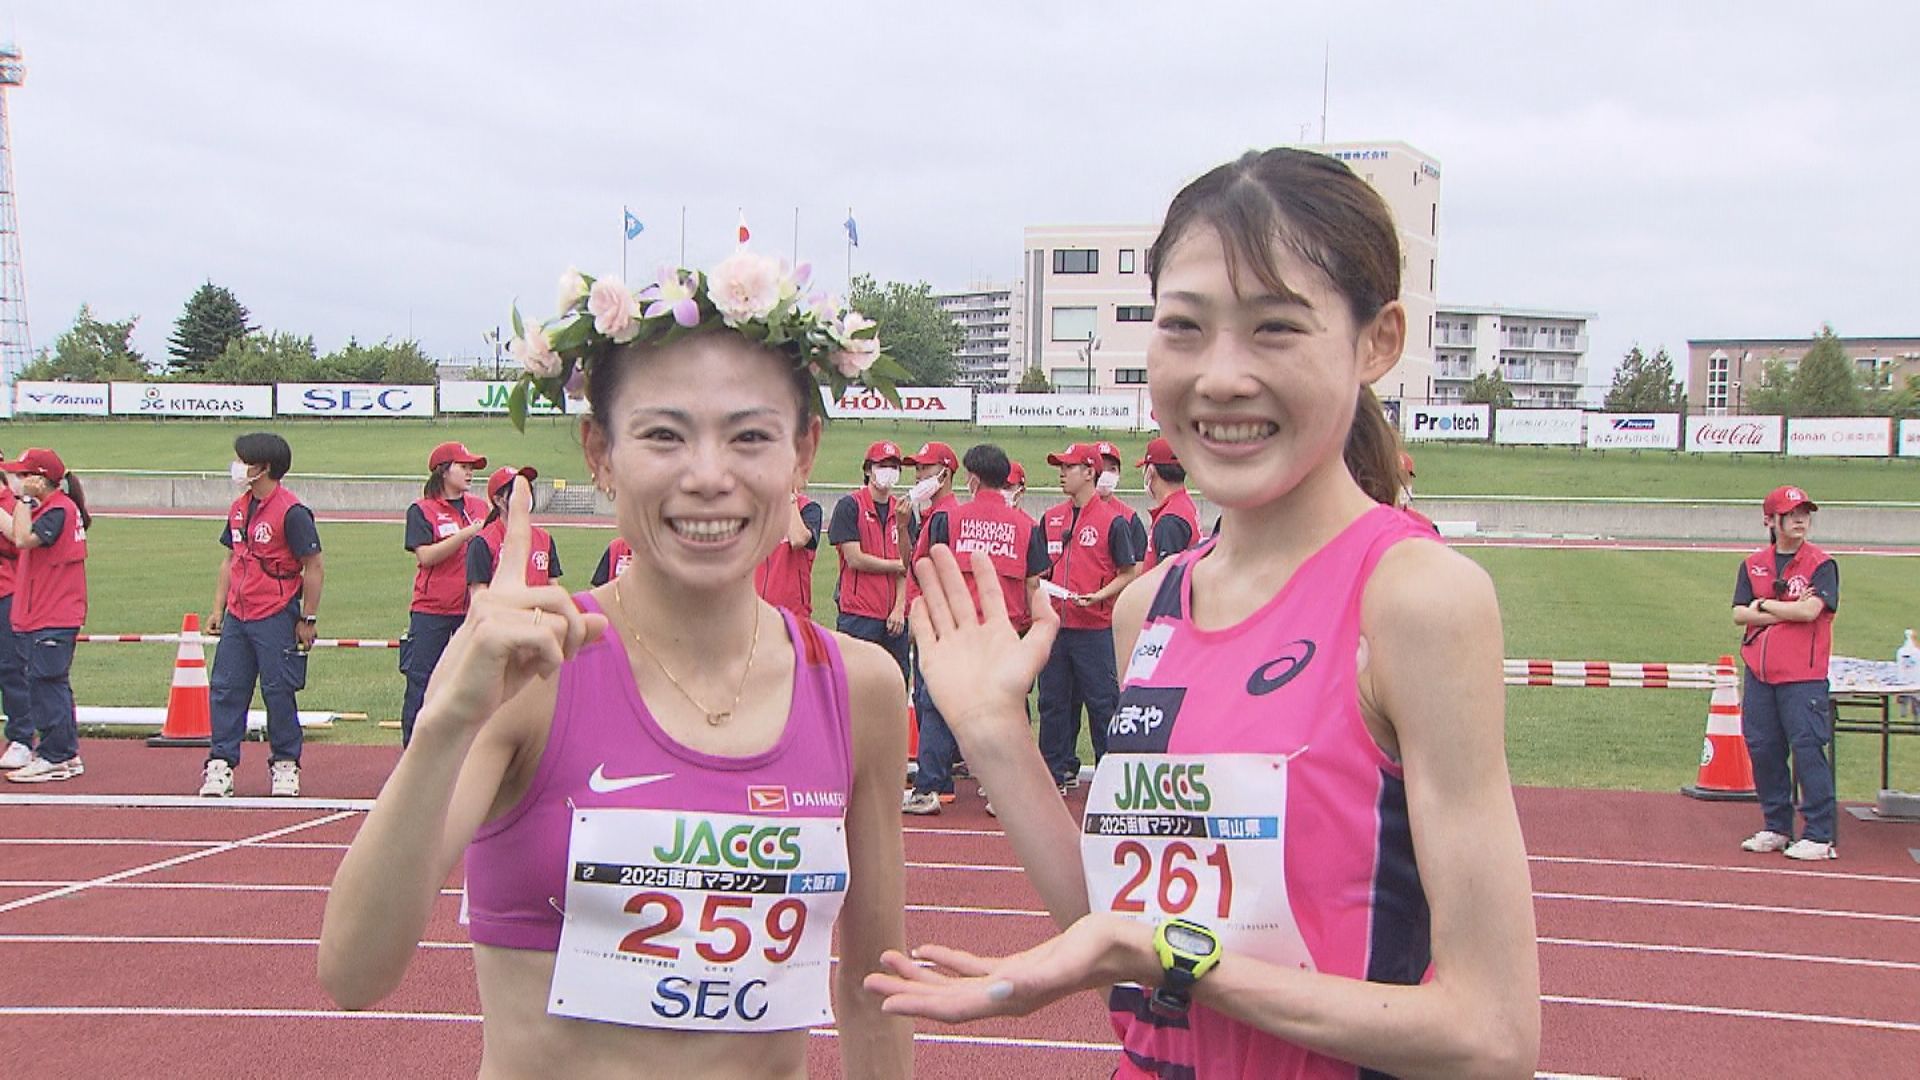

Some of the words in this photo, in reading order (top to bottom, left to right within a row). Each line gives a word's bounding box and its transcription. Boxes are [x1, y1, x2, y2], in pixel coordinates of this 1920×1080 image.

[170, 399, 244, 412] KITAGAS
[302, 389, 412, 411] SEC
[1009, 405, 1052, 416] Honda
[1056, 405, 1085, 416] Cars
[1415, 413, 1479, 430] Protech
[1791, 433, 1826, 441] donan
[960, 519, 1016, 533] HAKODATE
[960, 529, 1015, 544] MARATHON
[956, 539, 1018, 559] MEDICAL
[1114, 762, 1211, 811] JACCS
[792, 791, 845, 807] DAIHATS
[653, 817, 801, 870] JACCS
[1111, 840, 1232, 919] 261
[618, 891, 808, 964] 259
[650, 977, 769, 1021] SEC
